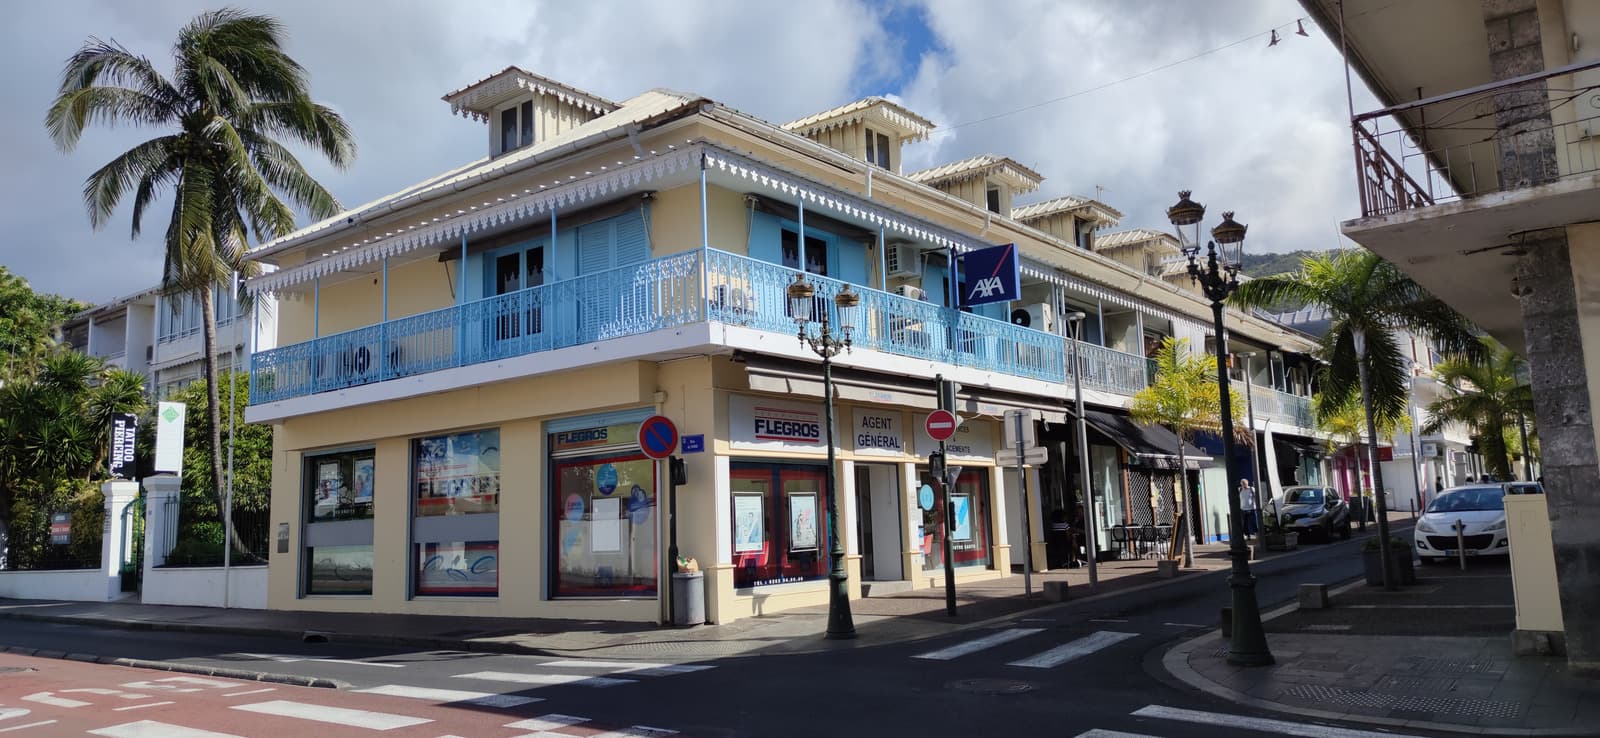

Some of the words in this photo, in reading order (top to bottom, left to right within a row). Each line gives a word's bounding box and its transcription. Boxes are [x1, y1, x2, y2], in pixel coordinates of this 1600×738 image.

[968, 276, 1005, 300] AXA
[755, 419, 820, 438] FLEGROS
[862, 416, 892, 430] AGENT
[113, 420, 126, 468] PIERCING
[124, 427, 135, 462] TATTOO
[558, 428, 608, 444] FLEGROS
[857, 431, 901, 448] GÉNÉRAL
